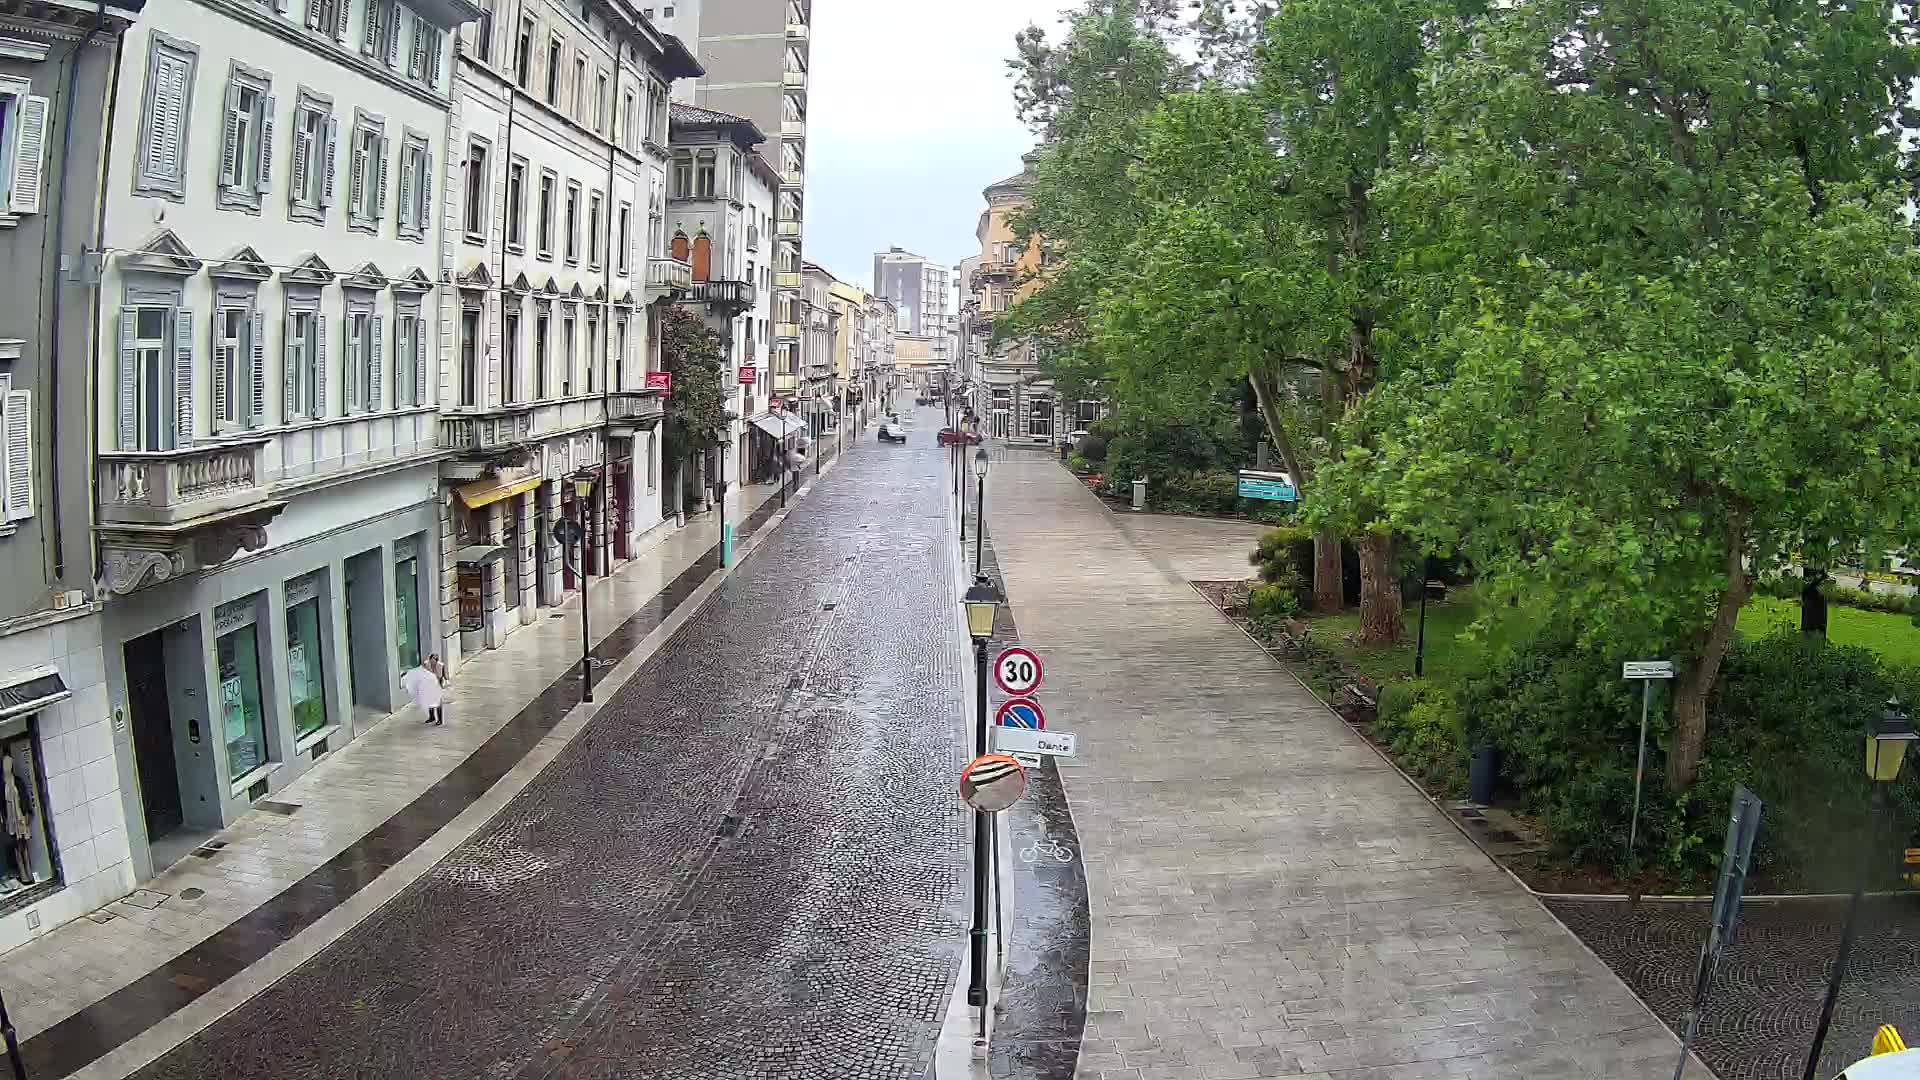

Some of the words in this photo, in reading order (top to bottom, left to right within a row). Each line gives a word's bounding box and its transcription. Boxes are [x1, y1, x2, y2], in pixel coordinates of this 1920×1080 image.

[1005, 660, 1033, 683] 30
[224, 679, 240, 702] 130
[1038, 740, 1070, 752] Dante
